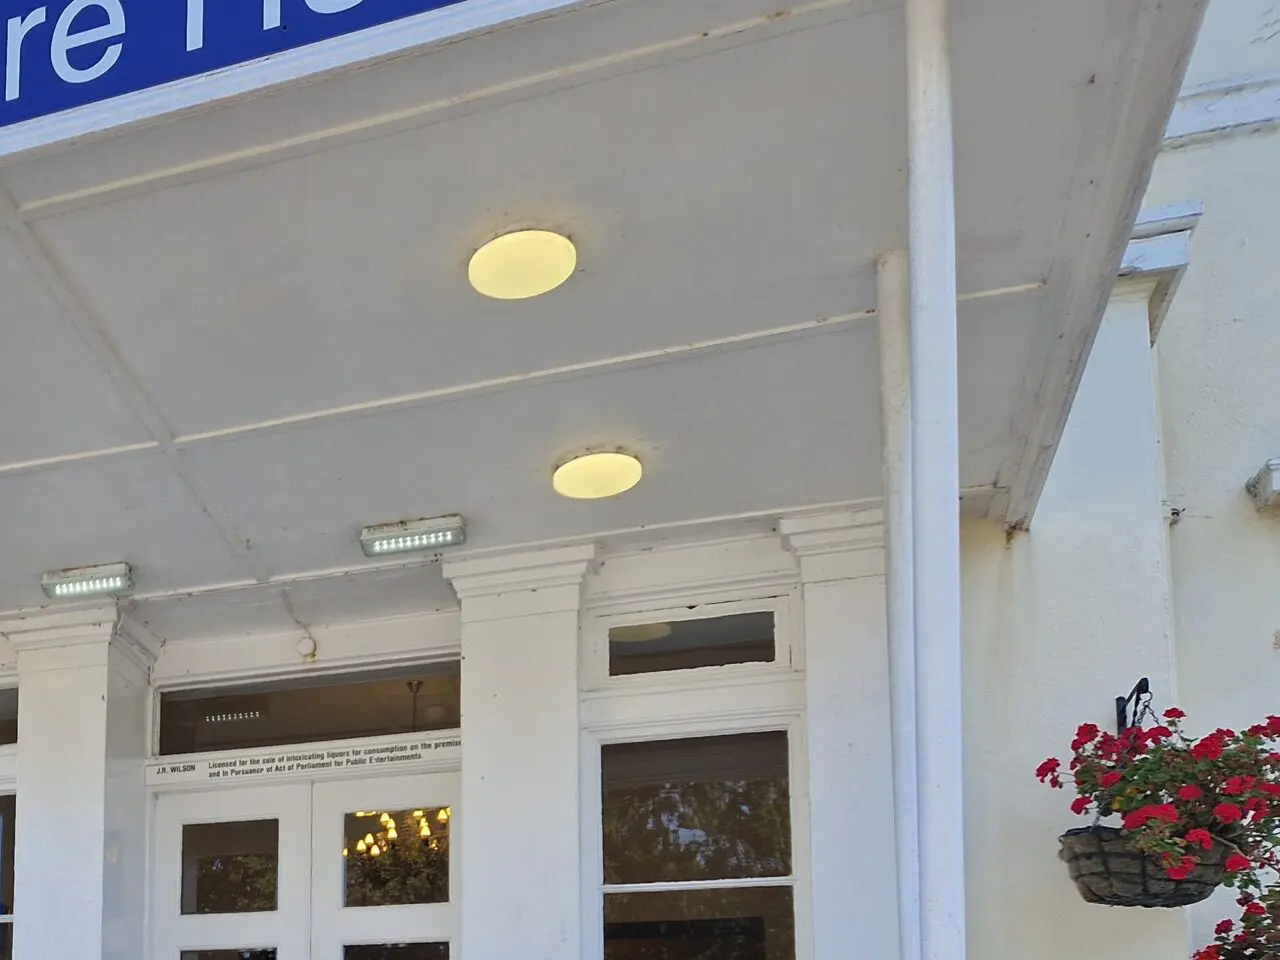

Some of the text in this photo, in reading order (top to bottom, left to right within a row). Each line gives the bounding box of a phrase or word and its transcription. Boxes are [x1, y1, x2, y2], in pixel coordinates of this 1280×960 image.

[208, 760, 237, 769] Licensed
[287, 752, 324, 762] intoxicating
[327, 750, 350, 759] liquors
[364, 745, 408, 755] consumption
[420, 742, 432, 750] the
[156, 764, 196, 775] J.R. WILSON
[208, 770, 220, 778] and
[230, 767, 264, 776] Pursuance
[296, 761, 332, 771] Parliament
[346, 758, 367, 766] Public
